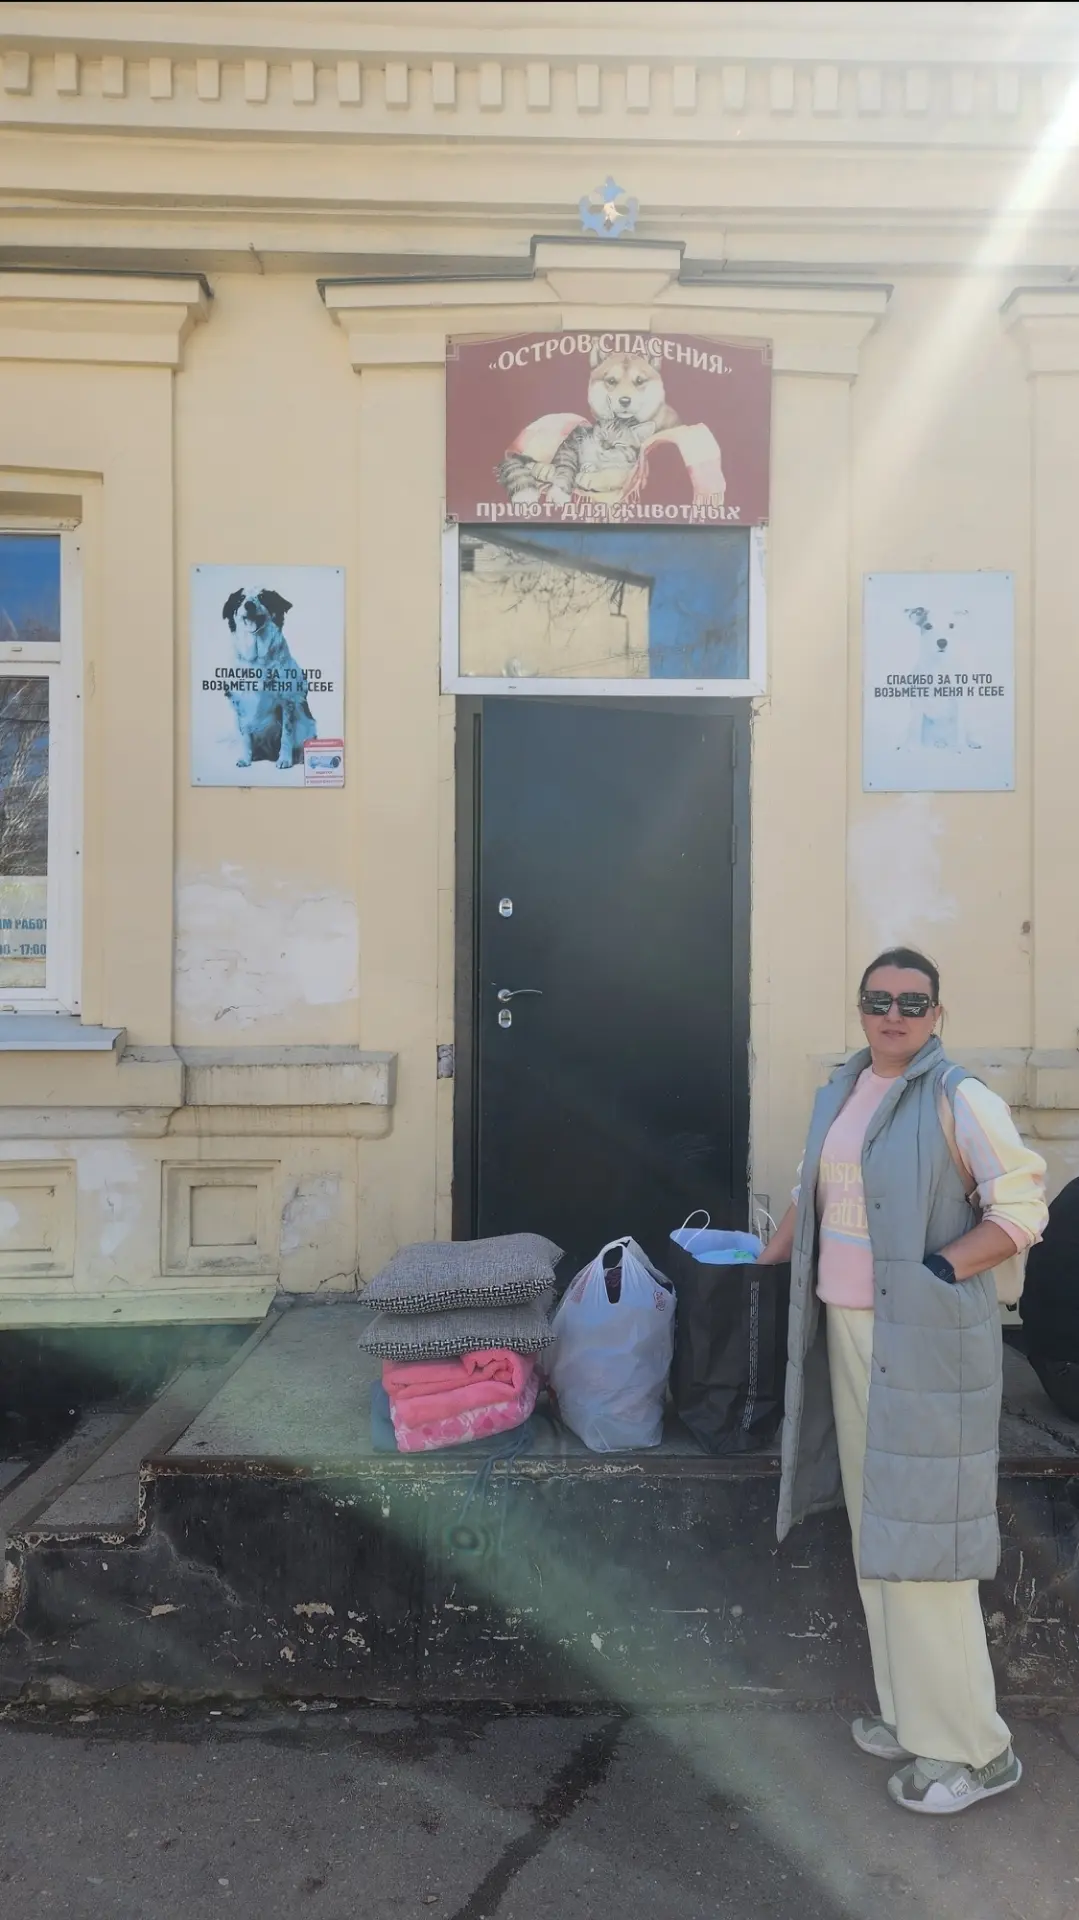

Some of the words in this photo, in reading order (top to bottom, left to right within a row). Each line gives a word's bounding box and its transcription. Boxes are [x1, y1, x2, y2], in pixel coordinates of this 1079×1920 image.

[488, 334, 592, 370] «ОСТРОВ
[599, 333, 732, 374] СПАСЕНИЯ»
[476, 503, 554, 521] приют
[561, 502, 606, 520] для
[613, 503, 740, 520] животных
[215, 668, 262, 678] СПАСИБО
[267, 668, 280, 679] ЗА
[284, 669, 297, 679] ТО
[302, 669, 321, 680] ЧТО
[886, 674, 933, 685] СПАСИБО
[938, 674, 951, 684] ЗА
[955, 674, 968, 684] ТО
[972, 673, 992, 684] ЧТО
[202, 679, 258, 691] ВОЗЬМЁТЕ
[263, 681, 292, 691] МЕНЯ
[297, 681, 303, 691] К
[308, 681, 334, 692] СЕБЕ
[874, 685, 930, 697] ВОЗЬМЁТЕ
[934, 686, 963, 697] МЕНЯ
[967, 686, 974, 696] К
[978, 686, 1004, 697] СЕБЕ
[20, 944, 46, 955] 17:00
